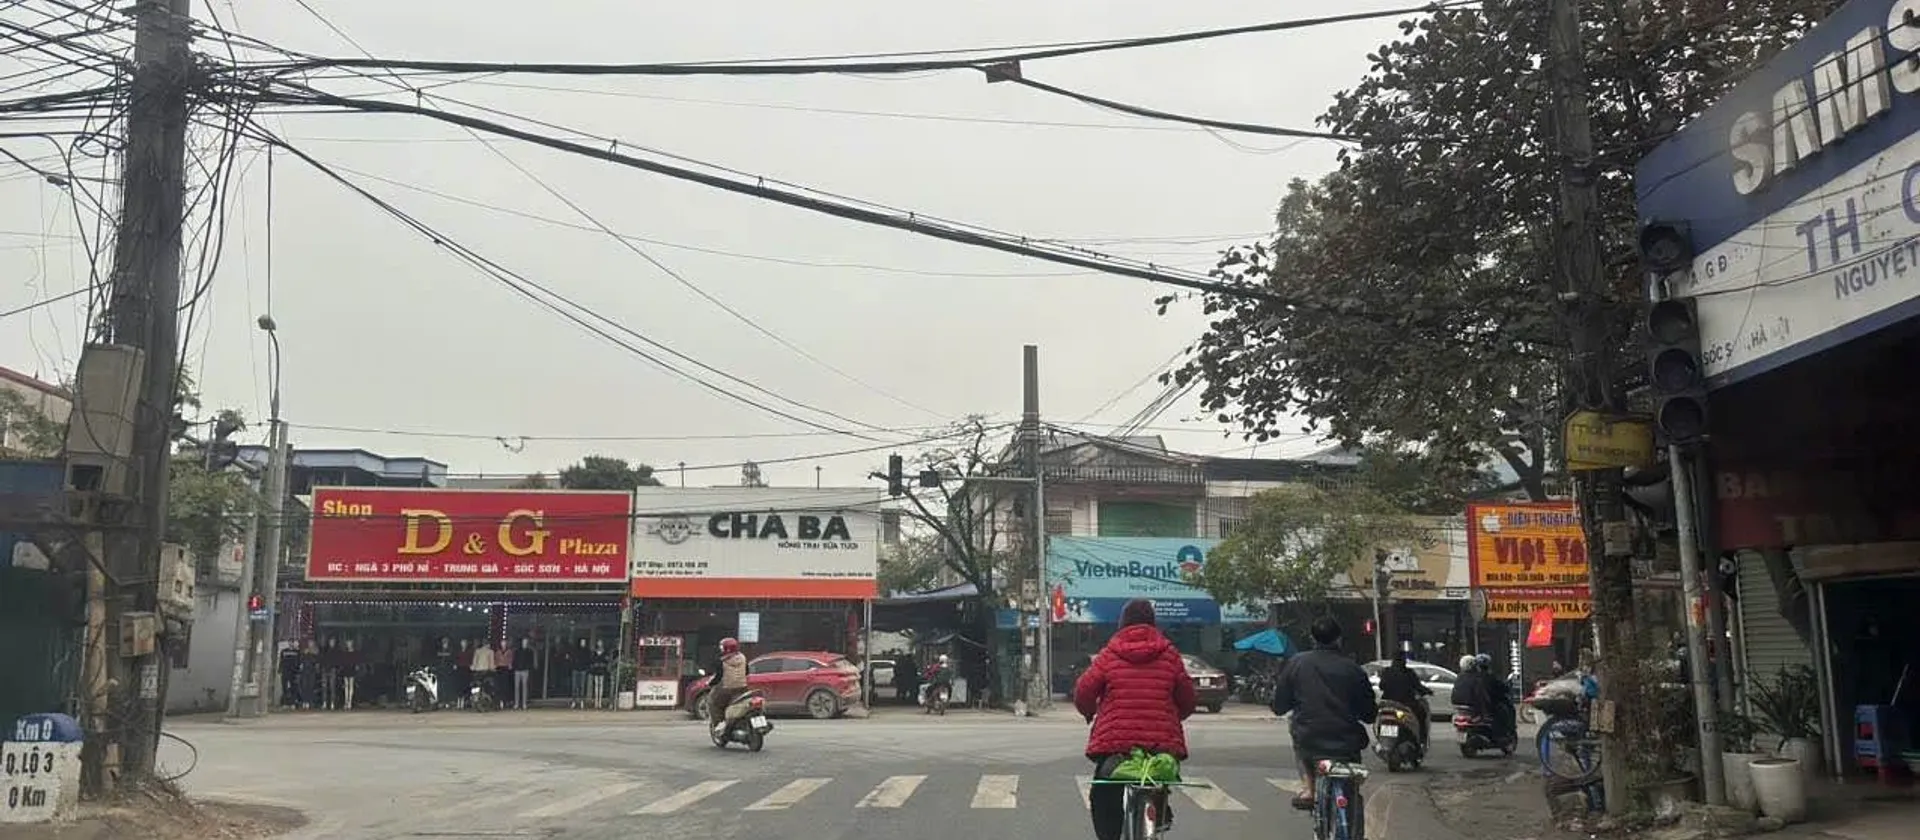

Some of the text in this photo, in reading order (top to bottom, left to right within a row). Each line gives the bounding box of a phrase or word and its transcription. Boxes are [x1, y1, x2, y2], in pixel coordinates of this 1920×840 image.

[1730, 0, 1920, 195] SAMS
[397, 508, 618, 556] D & G Plaza
[444, 563, 478, 573] TRUNG
[1074, 560, 1179, 579] VietinBank
[16, 719, 53, 740] Km 0
[43, 752, 54, 773] 3
[9, 785, 46, 808] 0 Km
